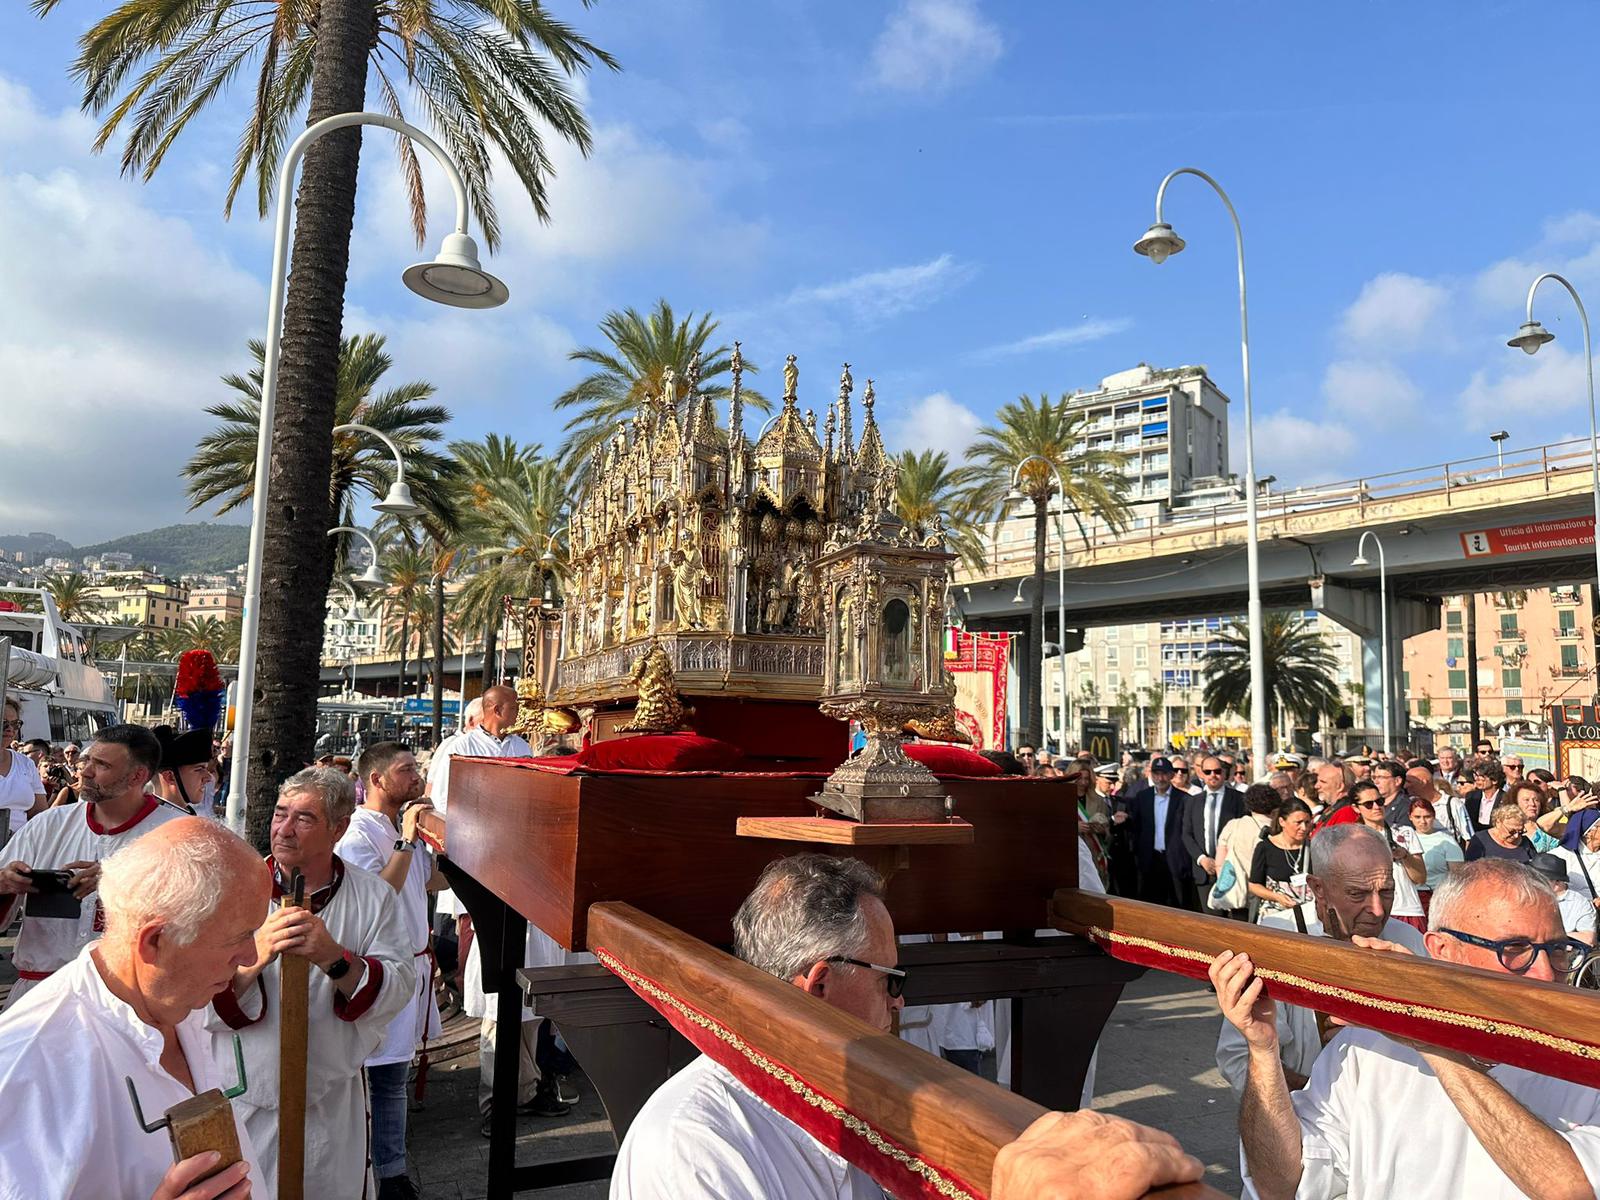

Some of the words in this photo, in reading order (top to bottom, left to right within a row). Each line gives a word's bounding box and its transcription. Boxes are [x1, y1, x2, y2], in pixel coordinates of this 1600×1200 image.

[1499, 527, 1525, 537] Ufficio
[1525, 525, 1534, 534] di
[1534, 520, 1587, 533] Informazione
[1504, 541, 1531, 552] Tourist
[1579, 535, 1596, 544] cen
[1565, 725, 1577, 739] A
